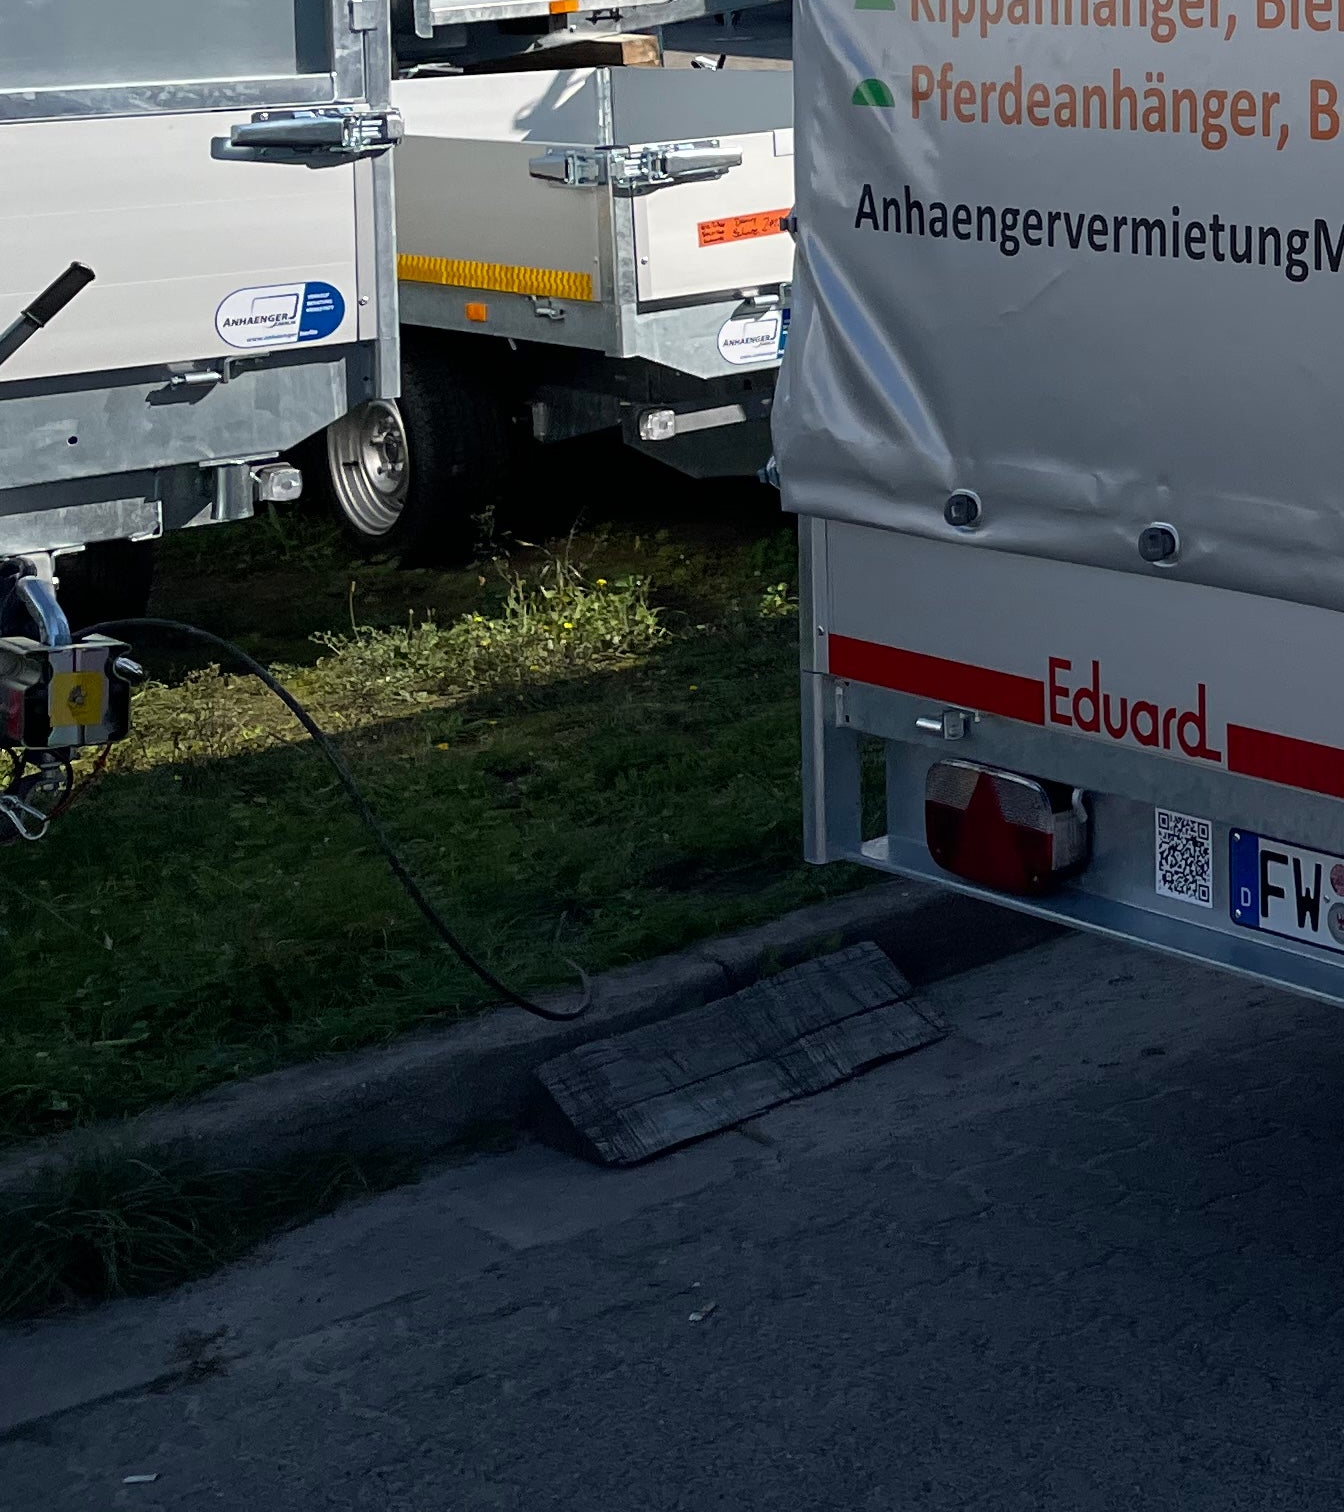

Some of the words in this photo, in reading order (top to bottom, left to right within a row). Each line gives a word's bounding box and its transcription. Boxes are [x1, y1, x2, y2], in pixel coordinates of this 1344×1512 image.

[910, 63, 1291, 152] Pferdeanhänger,
[222, 312, 290, 328] ANHAENGER
[1047, 655, 1223, 764] Eduard
[1259, 848, 1322, 932] FW
